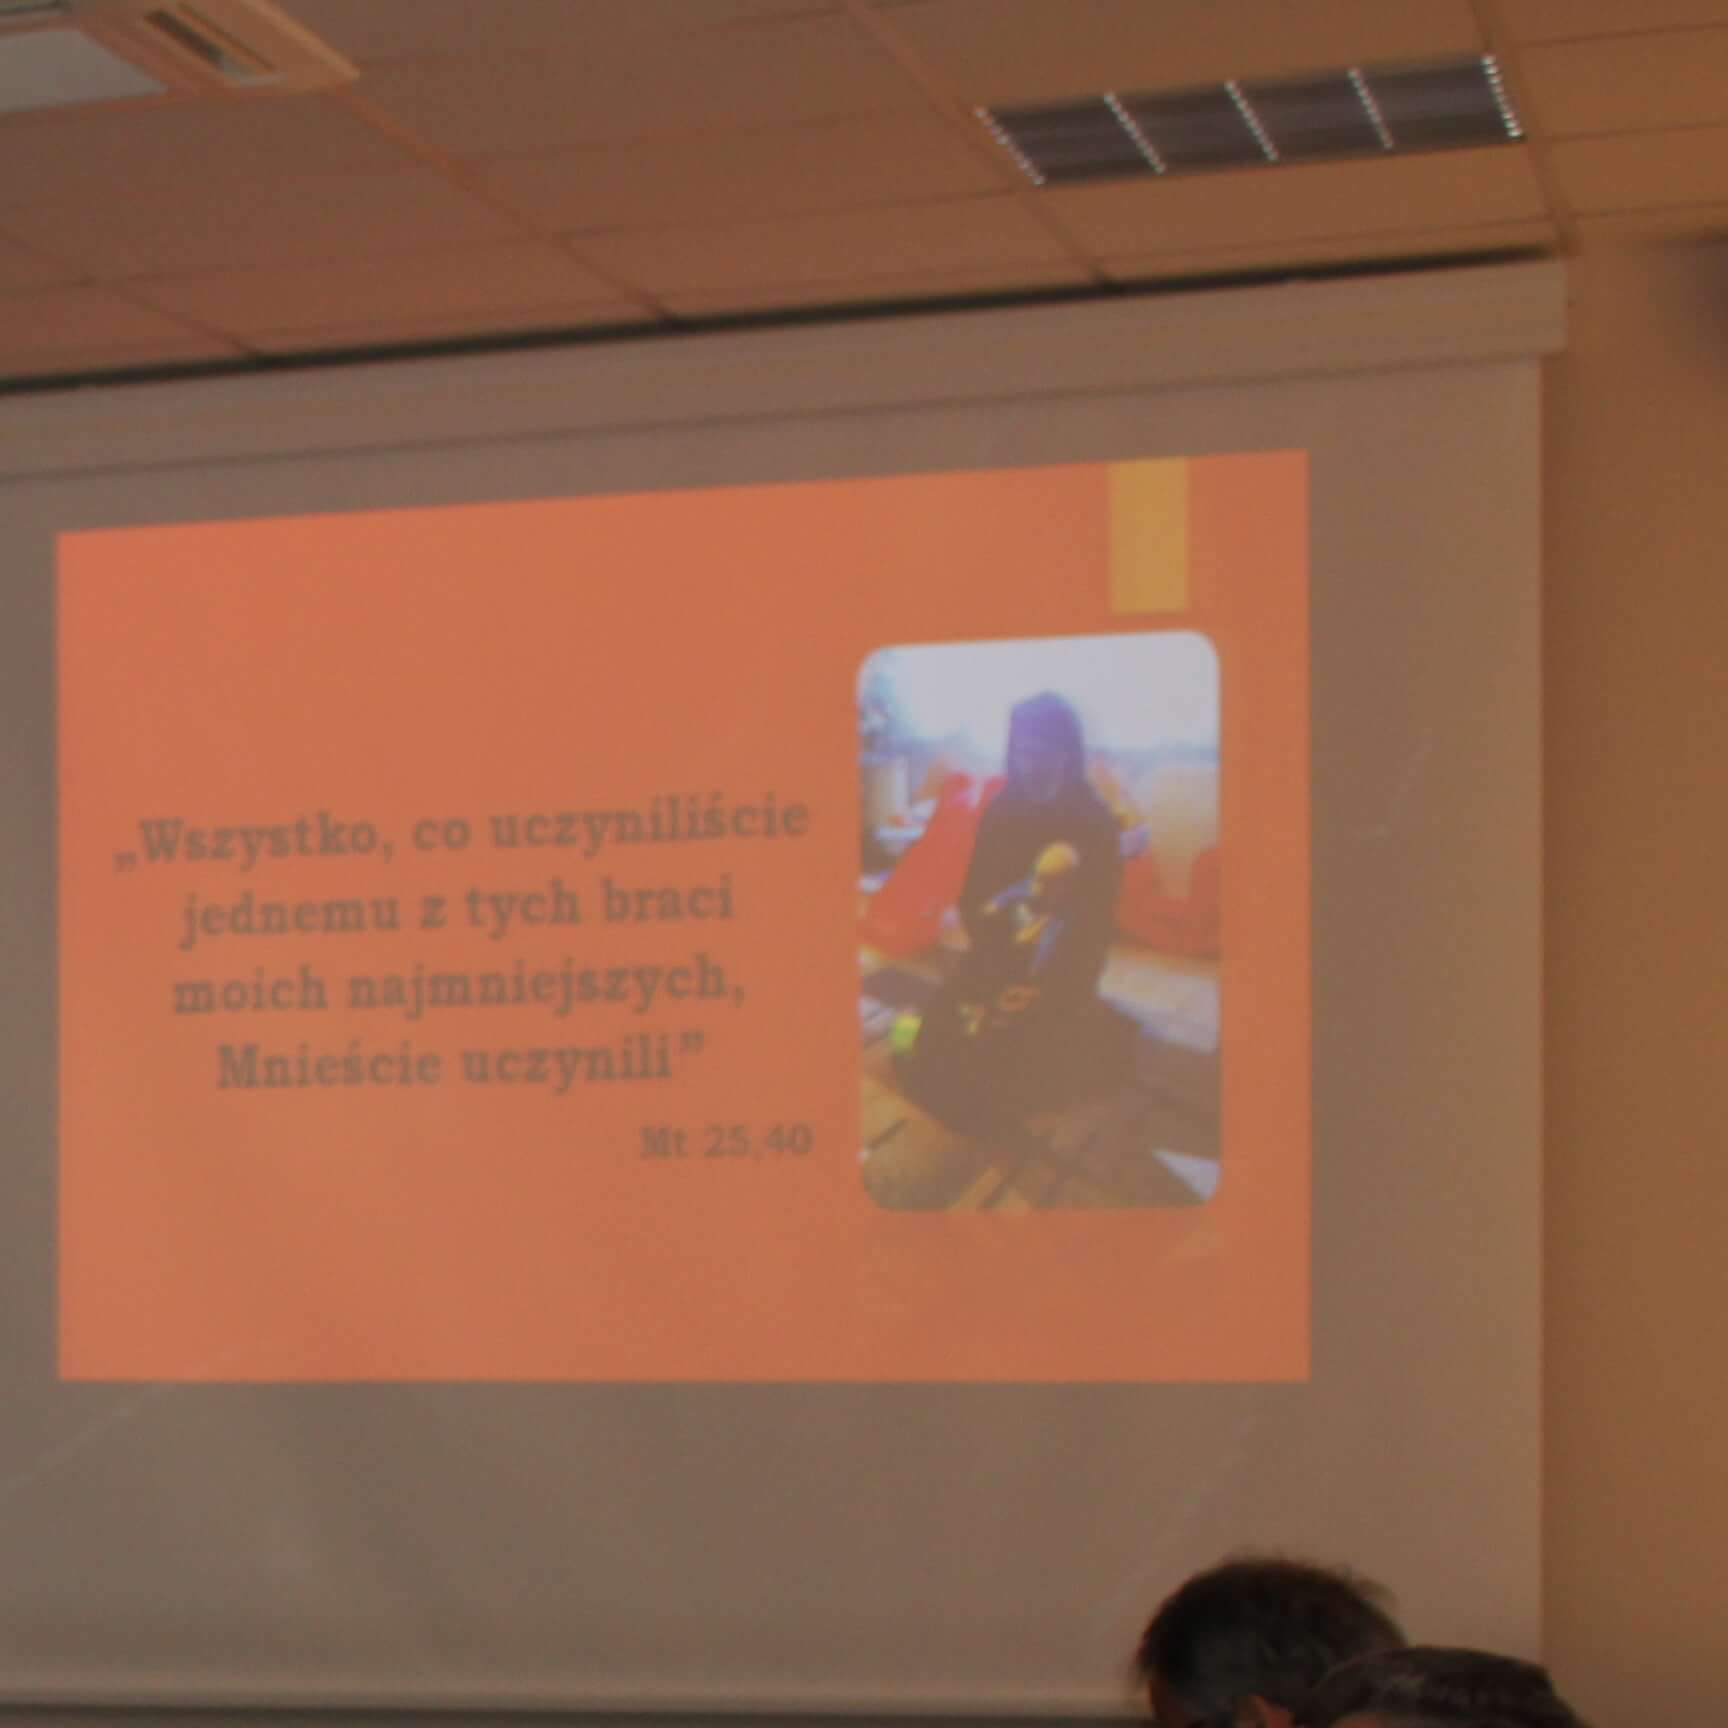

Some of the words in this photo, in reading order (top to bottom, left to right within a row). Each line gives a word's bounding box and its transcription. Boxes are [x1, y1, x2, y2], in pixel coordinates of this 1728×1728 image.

[411, 815, 474, 853] co
[488, 791, 812, 861] uczyniliście
[178, 890, 402, 953] jednemu
[417, 894, 449, 930] z
[463, 878, 585, 941] tych
[600, 873, 737, 924] braci
[172, 963, 330, 1017] moich
[346, 952, 748, 1021] najmniejszych,
[217, 1038, 443, 1091] Mnieście
[640, 1122, 690, 1161] Mt
